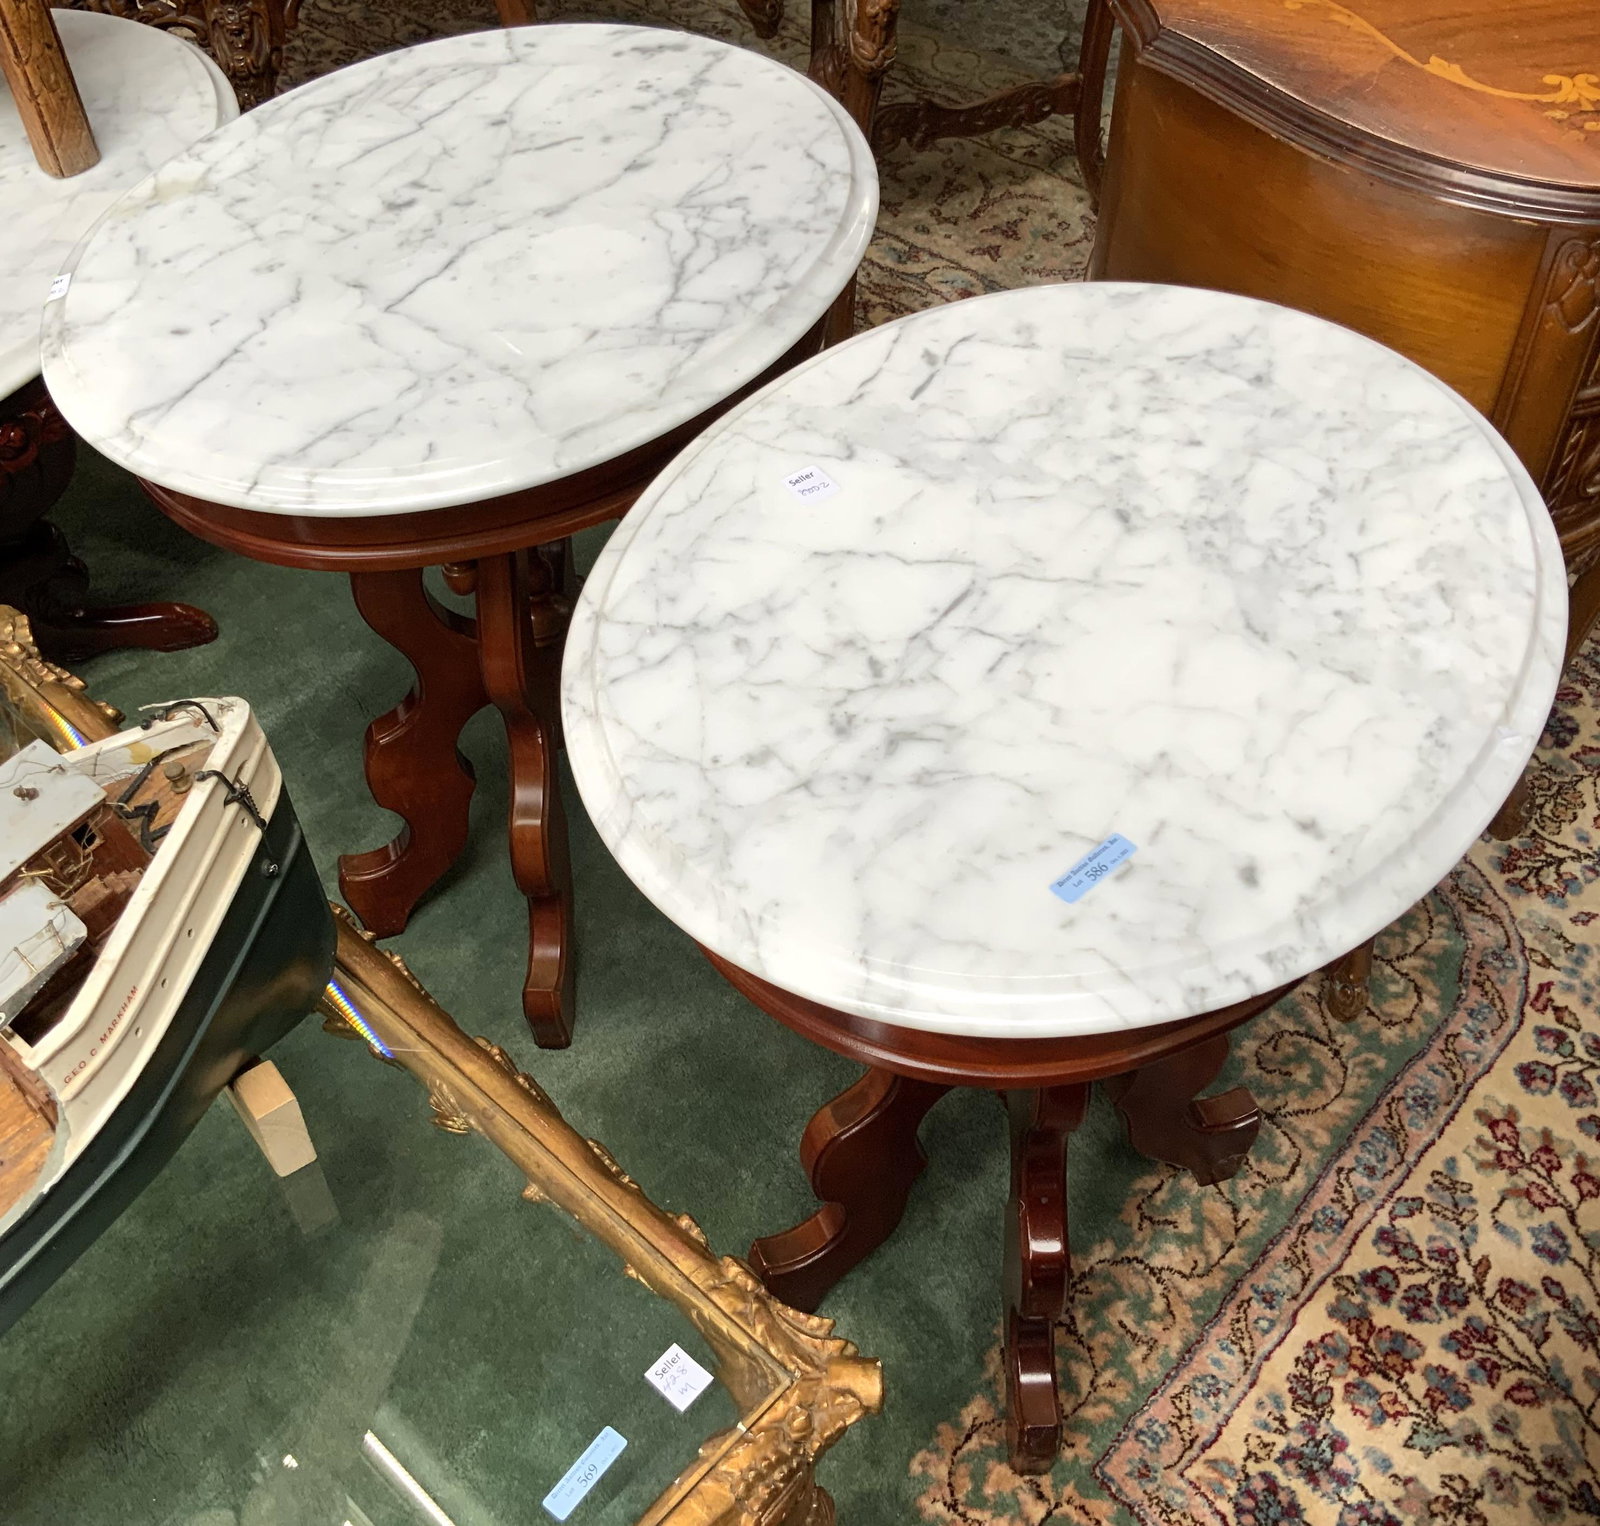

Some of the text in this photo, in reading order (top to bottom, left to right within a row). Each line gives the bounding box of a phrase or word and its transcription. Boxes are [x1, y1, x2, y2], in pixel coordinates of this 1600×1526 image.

[788, 471, 815, 487] Seller
[1084, 861, 1109, 882] 586
[64, 985, 138, 1084] GEO C MARKHAM
[654, 1352, 681, 1380] Seller
[576, 1463, 598, 1488] 569
